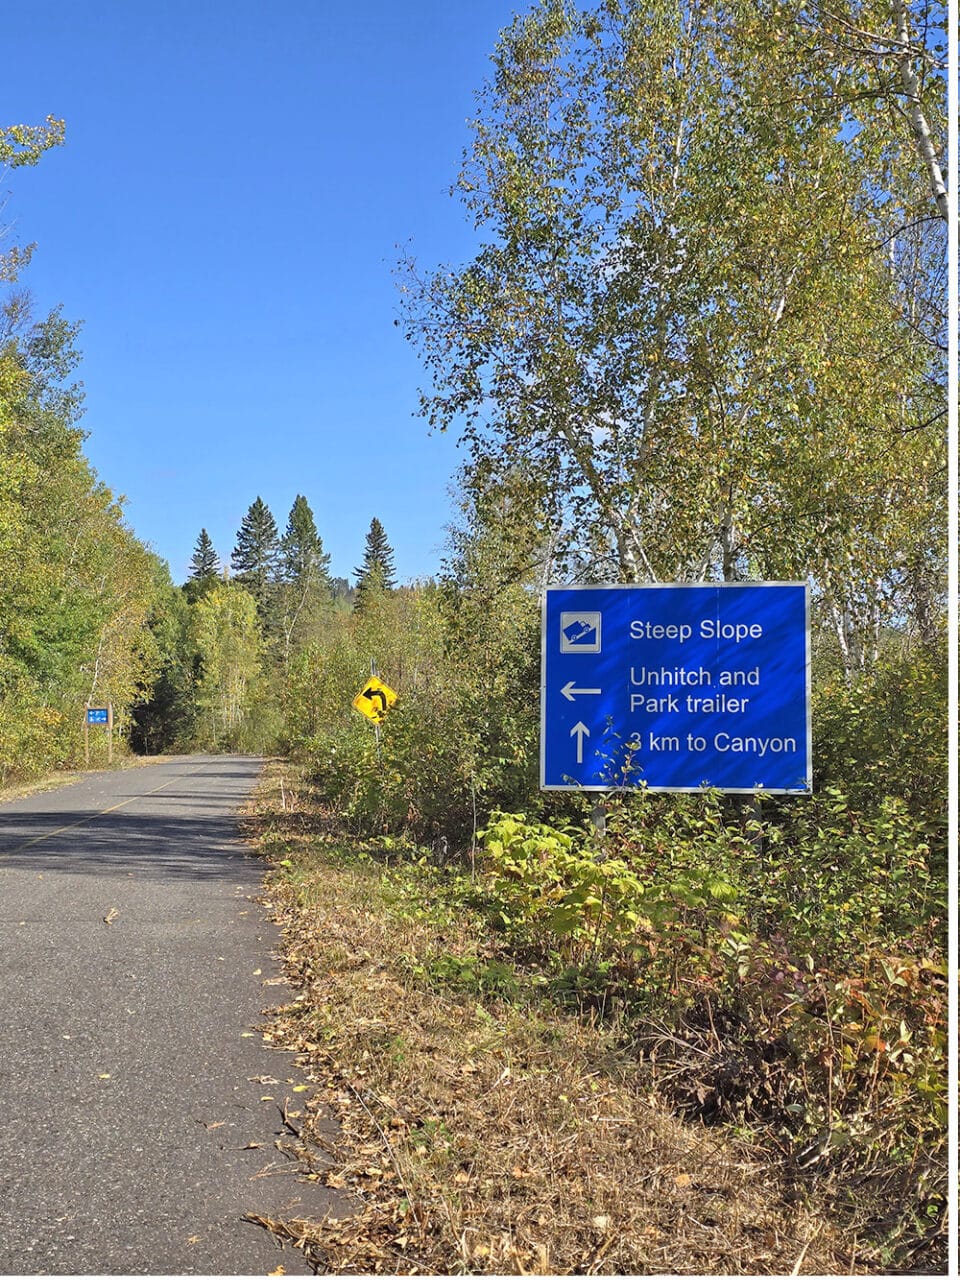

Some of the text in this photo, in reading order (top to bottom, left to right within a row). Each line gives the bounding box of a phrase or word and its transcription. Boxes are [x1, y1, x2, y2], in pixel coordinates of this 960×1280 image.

[630, 620, 763, 643] Steep Slope
[630, 667, 760, 686] Unhitch and
[630, 694, 750, 713] Park trailer
[629, 732, 796, 757] 3 km to Canyon
